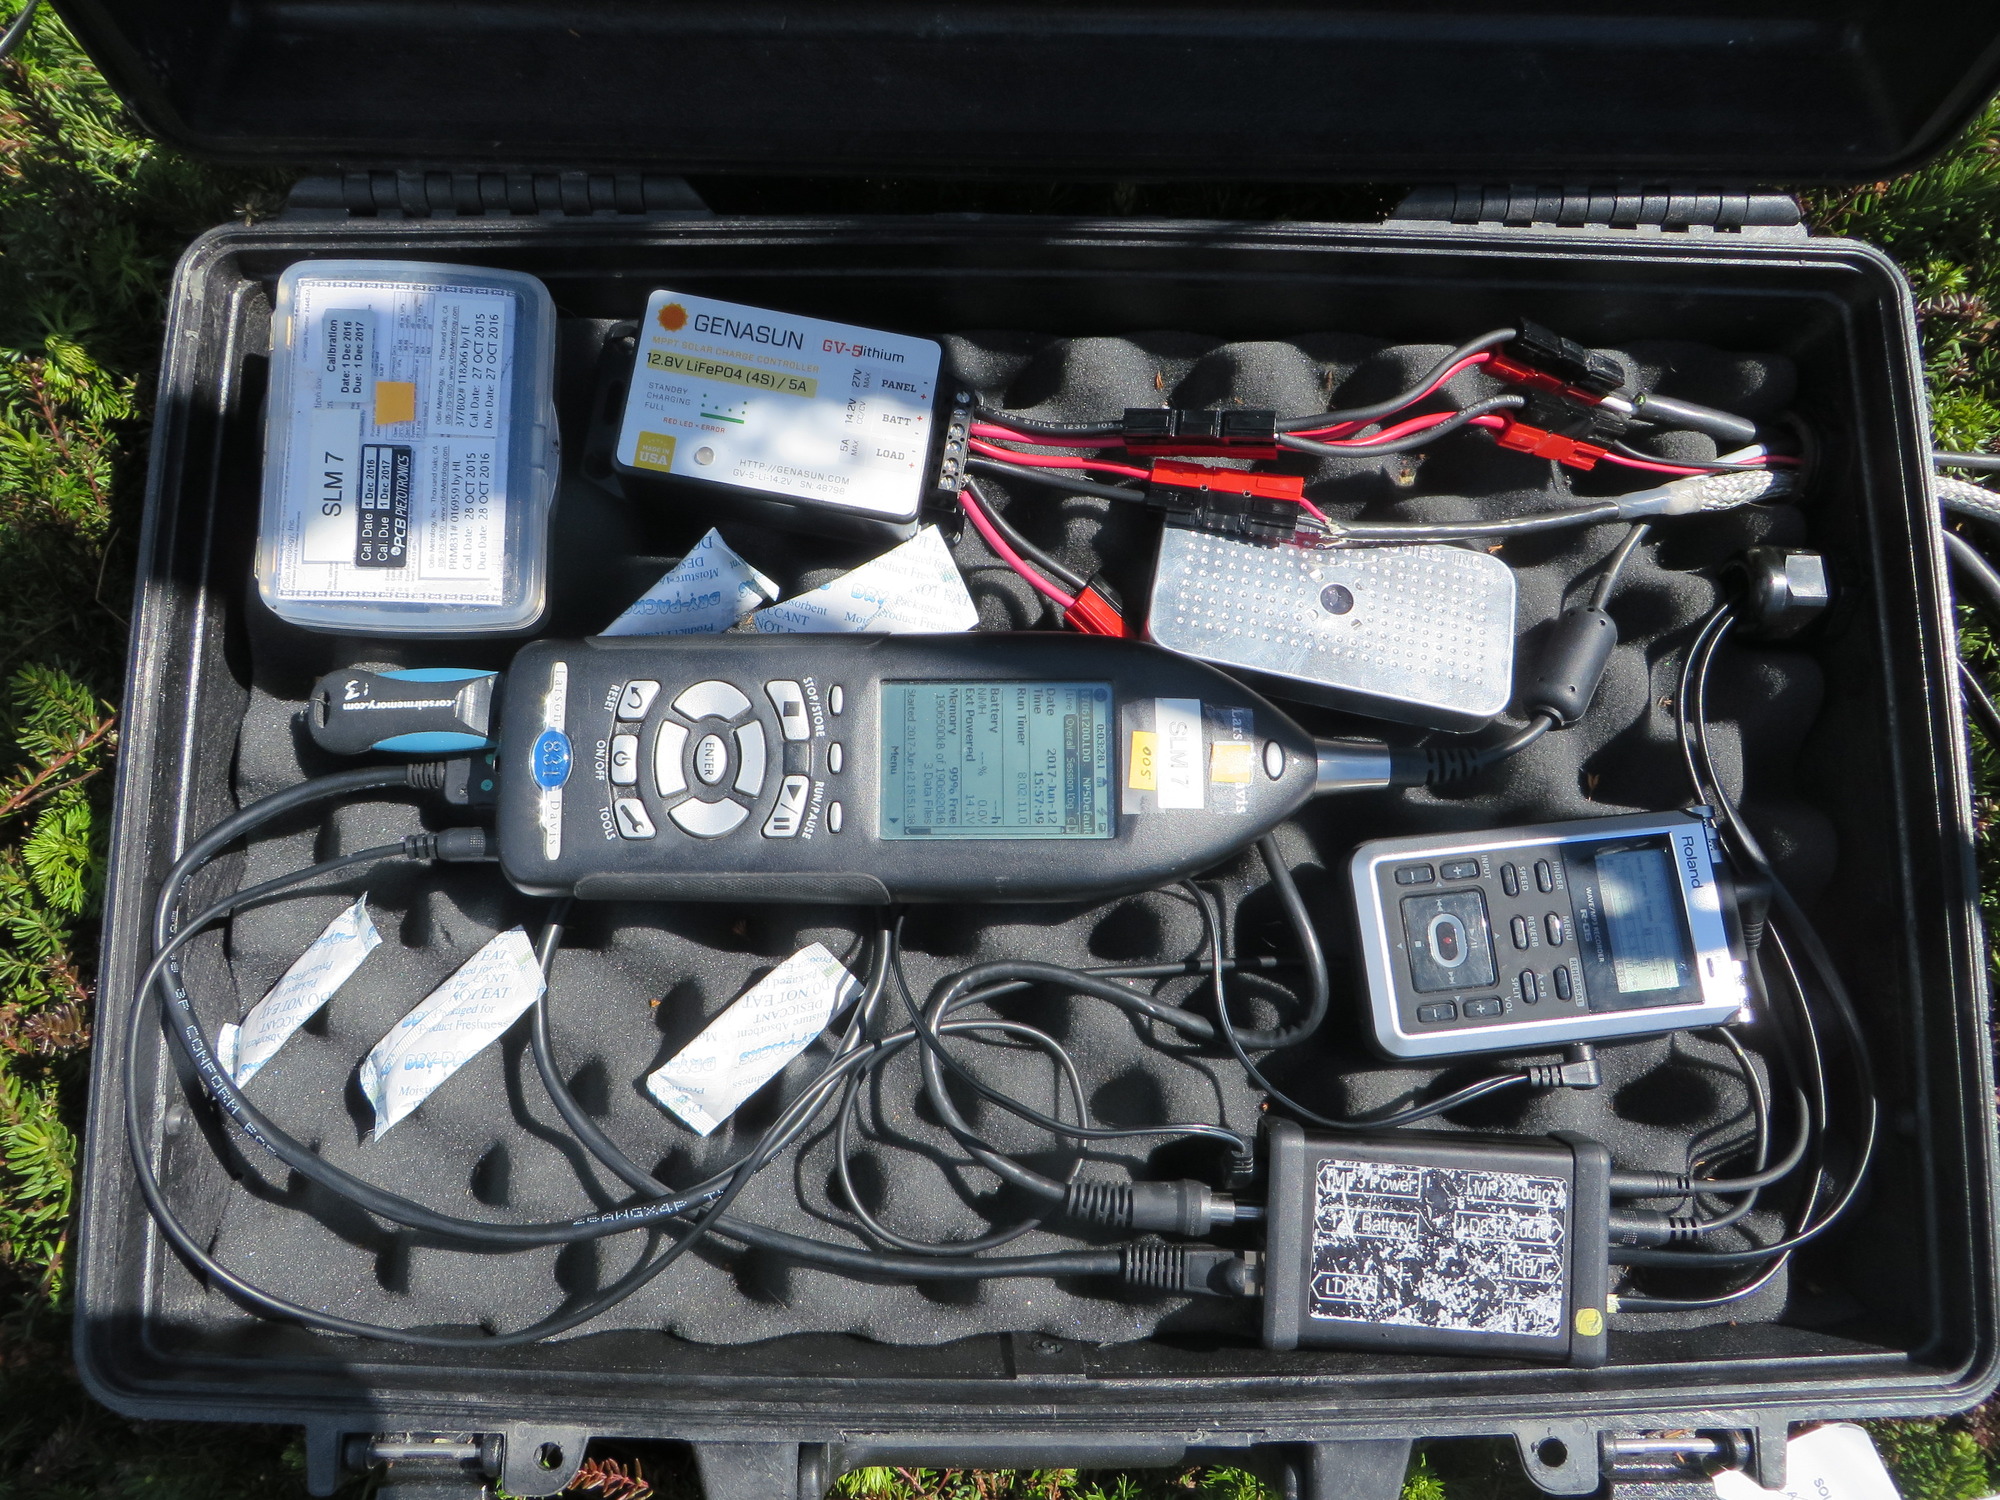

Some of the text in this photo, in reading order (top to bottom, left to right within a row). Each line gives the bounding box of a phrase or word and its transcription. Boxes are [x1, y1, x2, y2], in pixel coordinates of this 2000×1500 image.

[442, 305, 449, 314] CA
[343, 321, 352, 341] 2016
[355, 321, 364, 341] 2017
[694, 314, 803, 350] GENASUN
[326, 319, 338, 373] Calibration
[342, 344, 351, 361] Dec
[354, 344, 363, 361] Dec
[438, 331, 447, 360] Thousand
[652, 335, 820, 374] MPPT SOLAR CHARGE CONTROLLER
[340, 370, 350, 393] Date:
[456, 325, 471, 427] 377B02# 118266 by TE
[469, 313, 486, 428] Cal. Date: 27 OCT 2015
[484, 314, 499, 429] Due Date: 27 OCT 2016
[647, 352, 684, 369] 12.8V
[745, 370, 775, 388] (4S)
[777, 378, 786, 389] /
[788, 379, 807, 392] 5A
[852, 368, 862, 388] 27V
[863, 372, 871, 388] MAX
[353, 373, 362, 394] Due:
[648, 382, 689, 395] STANDBY
[881, 379, 917, 393] PANEL
[644, 401, 665, 412] FULL
[646, 391, 691, 406] CHARGING
[845, 398, 857, 424] 14.2V
[663, 416, 725, 433] RED LED ERROR
[882, 414, 912, 426] BATT
[1024, 418, 1056, 429] STYLE
[1063, 422, 1087, 430] 1230
[432, 445, 438, 455] CA
[642, 445, 661, 453] MADE
[840, 439, 850, 452] 5A
[851, 440, 859, 456] MAX
[876, 448, 905, 461] LOAD
[366, 460, 375, 480] 2016
[381, 460, 390, 480] 2017
[640, 451, 668, 466] USA
[322, 451, 344, 516] SLM 7
[451, 474, 462, 486] by
[740, 459, 850, 485] HTTP://GENASUN.COM
[365, 483, 374, 499] Dec
[380, 483, 389, 500] Dec
[394, 454, 409, 548] PCB PIEZOTRONICS
[450, 488, 460, 523] 016959
[463, 452, 476, 570] Cal. Date: 28 OCT 2015
[477, 452, 490, 570] Due Date: 28 OCT 2016
[362, 513, 374, 537] Date
[378, 517, 390, 538] Due
[361, 540, 373, 561] Cal.
[377, 540, 389, 561] Cal.
[603, 684, 620, 712] RESET
[802, 677, 826, 738] STOP/STORE
[907, 688, 917, 722] Started
[989, 688, 999, 734] Battery
[1065, 718, 1075, 749] Overall
[542, 740, 563, 778] 831
[548, 669, 566, 846] Larson Davis
[908, 726, 917, 780] 2017-Jun-12
[936, 753, 946, 764] of
[947, 688, 958, 824] Memory 99% Free
[965, 688, 976, 823] Ext Powered 14.1V
[978, 688, 987, 824] NiMH 0.0V
[1017, 688, 1028, 824] Run Timer 8:02:11.0
[1034, 688, 1044, 824] Time 15:57:49
[1047, 688, 1057, 824] Date 2017-Jun-12
[1096, 724, 1105, 769] 0:03:28.1
[1168, 721, 1190, 788] SLM 7
[594, 740, 607, 781] ON/OFF
[704, 742, 715, 777] ENTER
[890, 746, 899, 774] Menu
[1231, 708, 1249, 813] Lars avis
[923, 772, 933, 797] Data
[1066, 757, 1076, 790] Session
[801, 781, 825, 840] RUN/PAUSE
[924, 800, 933, 824] Files
[598, 806, 616, 841] TOOLS
[1480, 855, 1492, 879] INPUT
[1681, 836, 1703, 889] Roland
[1518, 866, 1529, 891] SPEED
[1553, 861, 1564, 890] FINDER
[1528, 916, 1540, 947] REVERB
[1562, 915, 1573, 941] MENU
[1586, 887, 1605, 962] WAVE/MP3 RECORDER
[480, 986, 512, 999] EAT
[1510, 977, 1521, 1000] SPLIT
[1570, 960, 1584, 1005] REHEARSAL
[741, 994, 774, 1009] EAT
[779, 988, 809, 1004] NOT
[1504, 996, 1514, 1014] VOL
[753, 999, 823, 1025] DESICCANT
[455, 1019, 509, 1031] Freshness
[737, 1020, 790, 1039] Absorbent
[185, 1024, 241, 1115] CONFORM
[1332, 1171, 1415, 1192] MP3 Power
[1474, 1183, 1551, 1201] MP3 Audio
[1361, 1213, 1412, 1236] Battery
[1510, 1219, 1550, 1239] Audio
